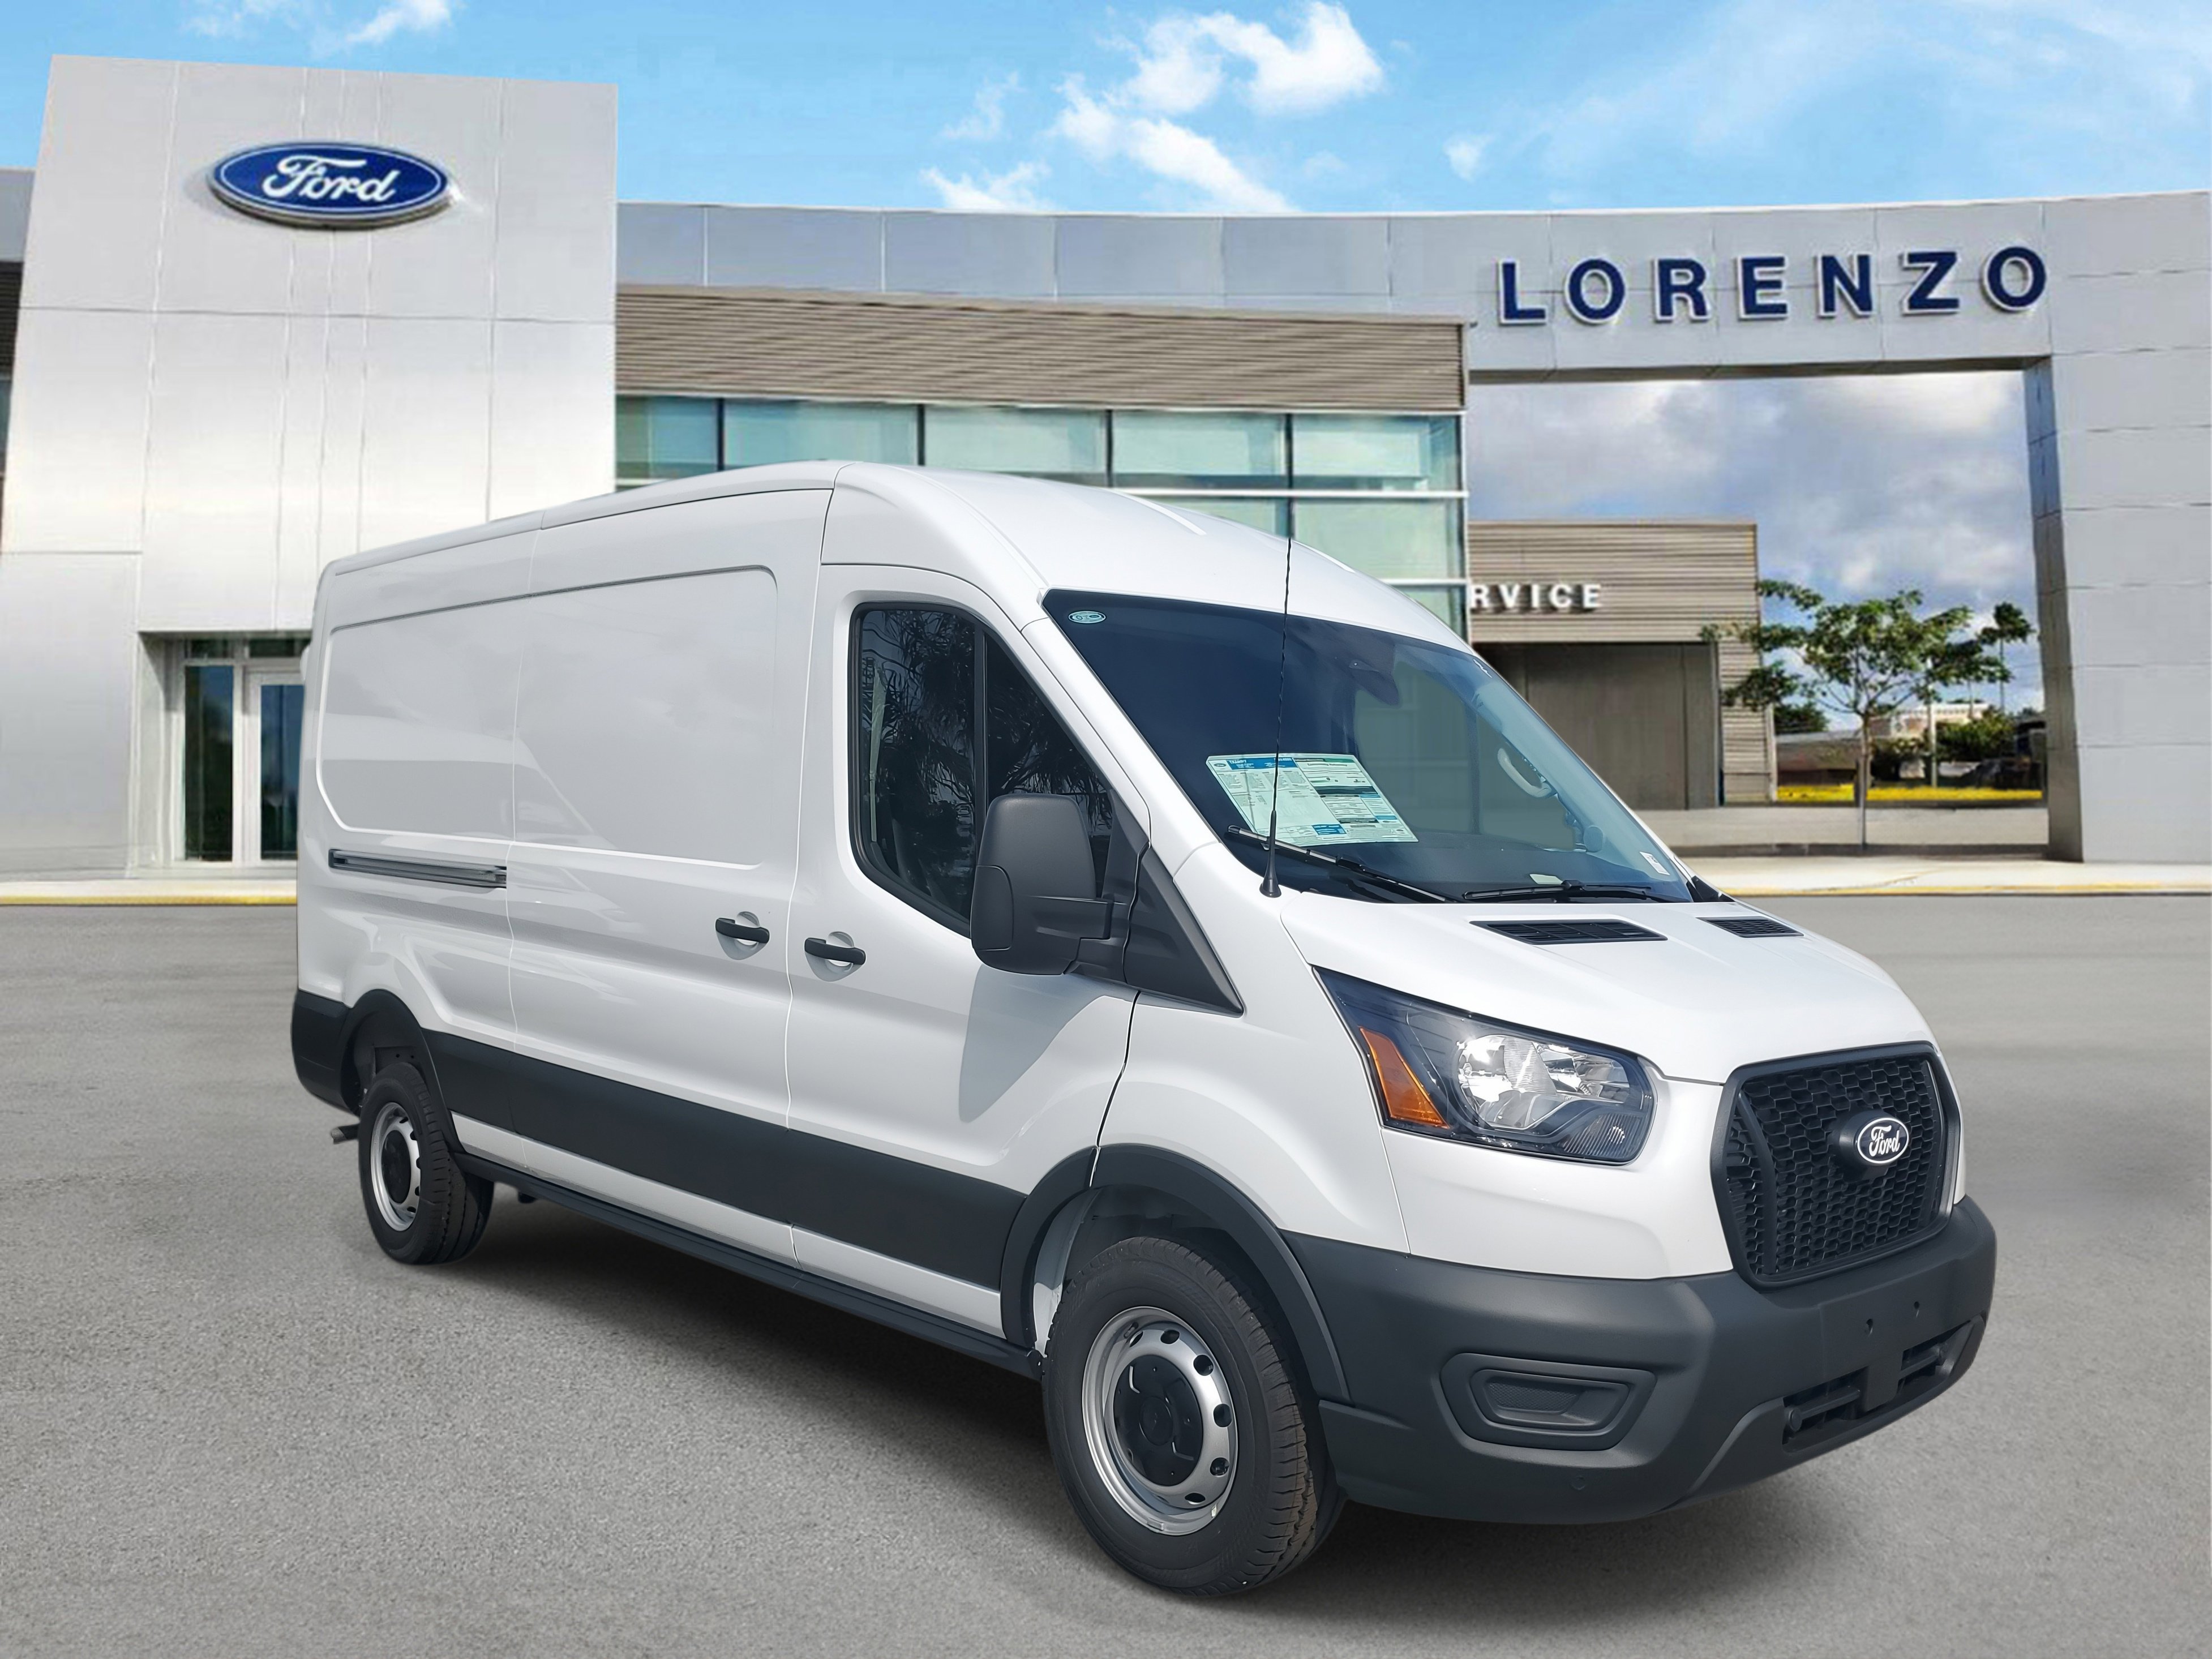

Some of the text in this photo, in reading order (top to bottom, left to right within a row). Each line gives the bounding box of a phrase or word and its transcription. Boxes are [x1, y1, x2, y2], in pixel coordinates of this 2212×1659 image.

[262, 154, 401, 202] Ford
[1499, 246, 2047, 324] LORENZO
[1470, 583, 1602, 608] RVICE
[1869, 1125, 1900, 1157] Ford
